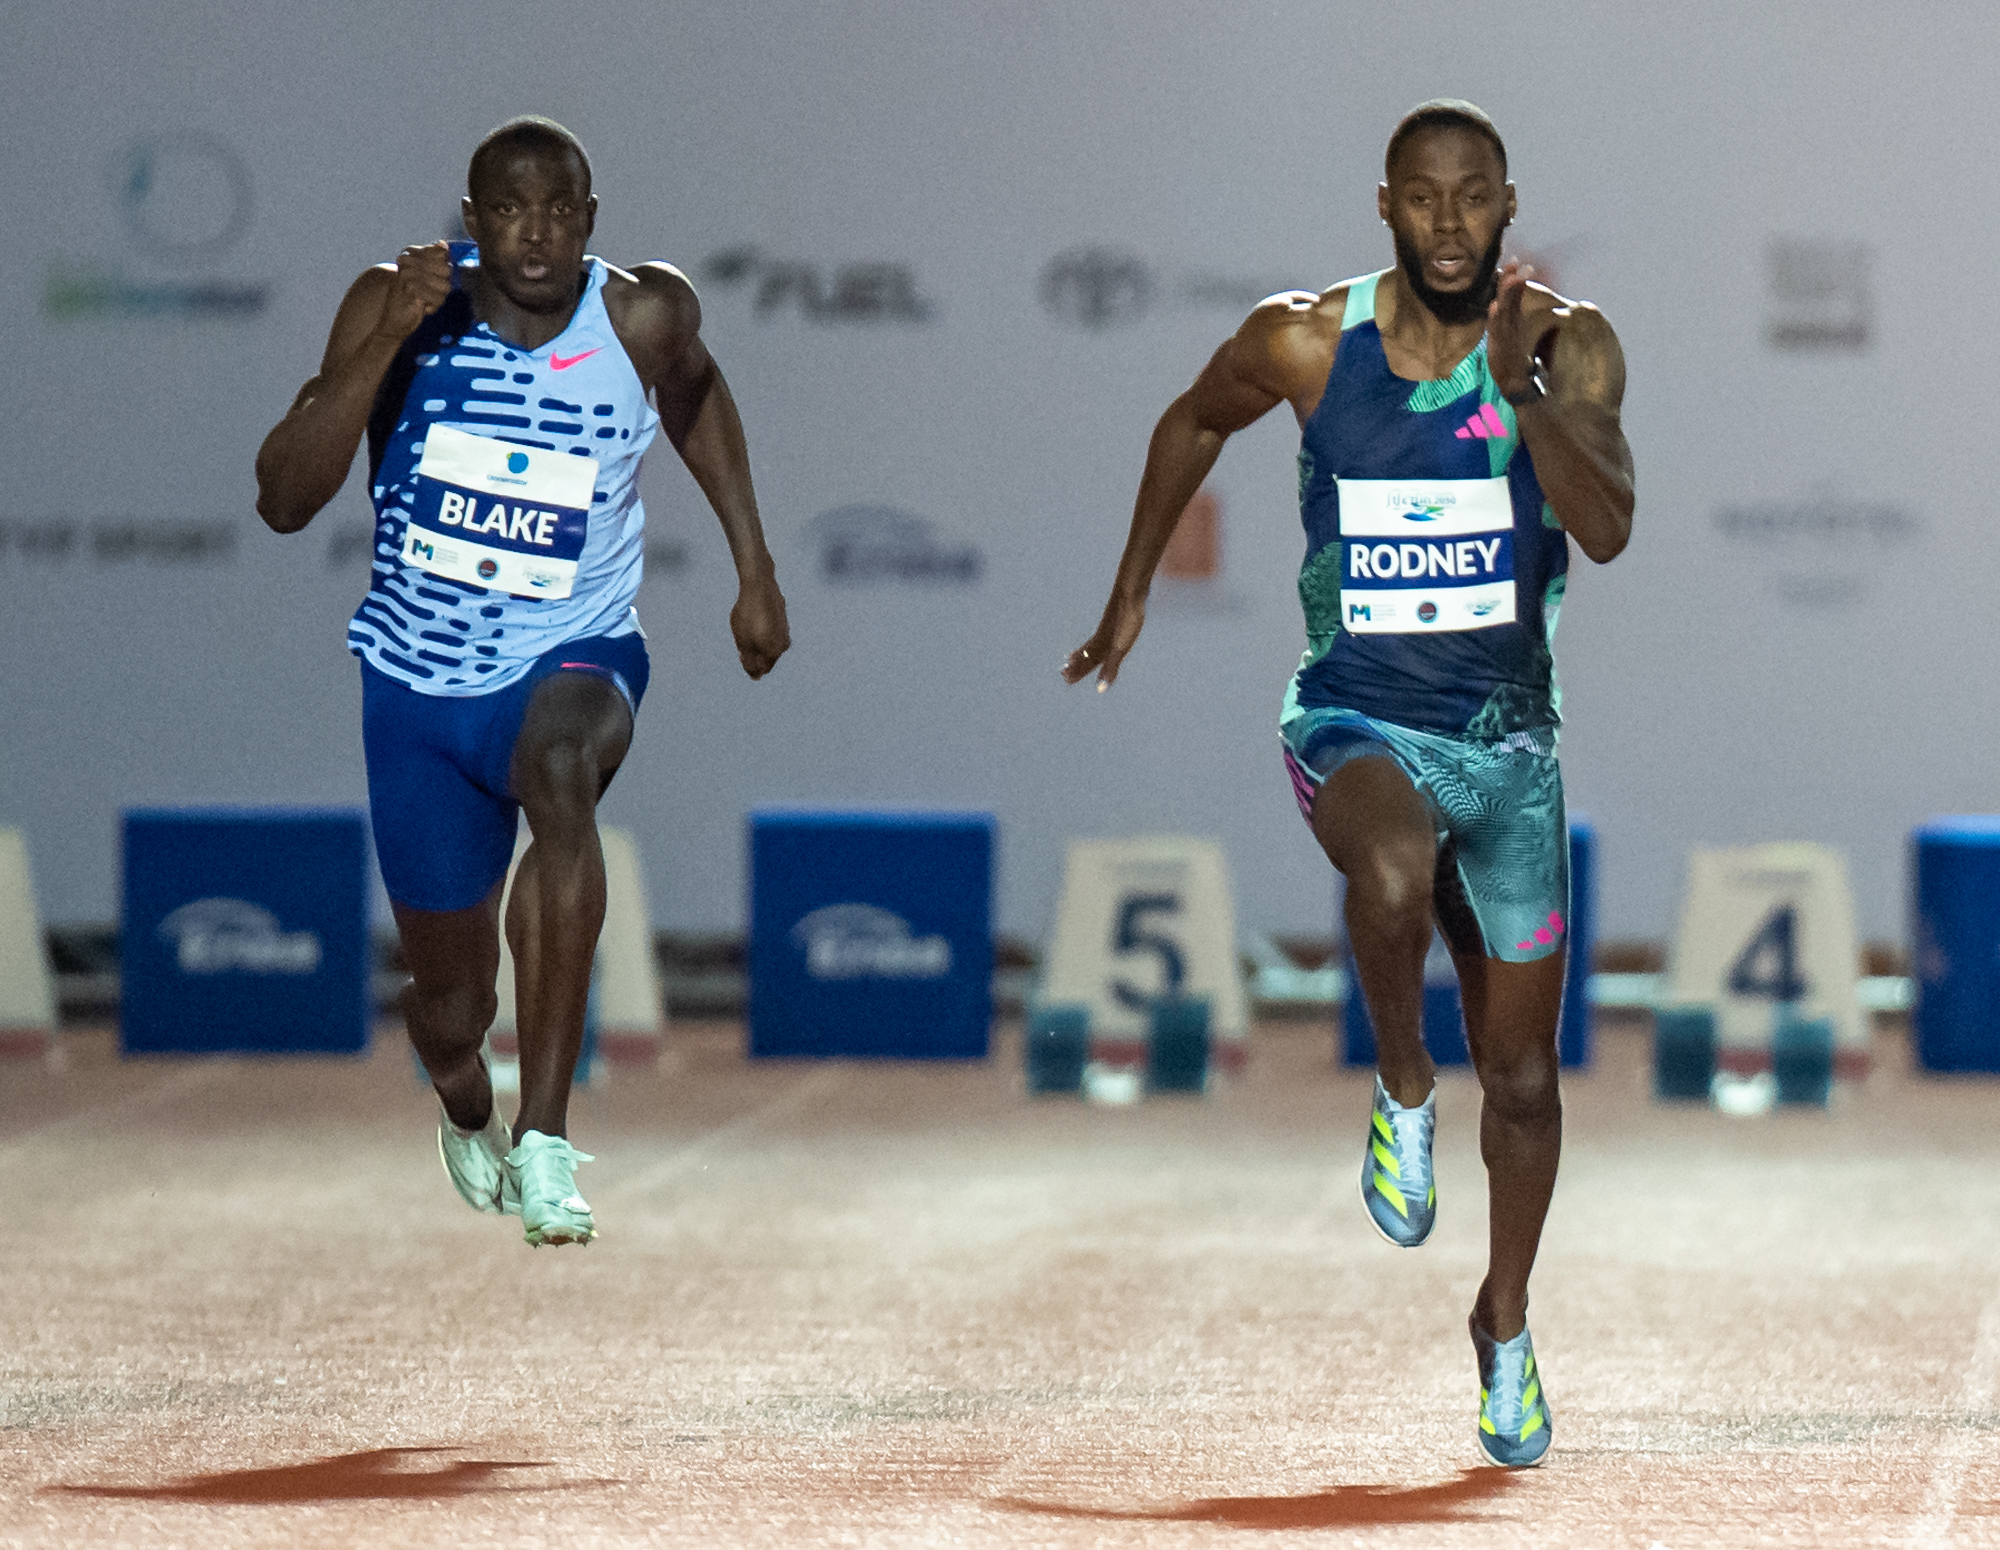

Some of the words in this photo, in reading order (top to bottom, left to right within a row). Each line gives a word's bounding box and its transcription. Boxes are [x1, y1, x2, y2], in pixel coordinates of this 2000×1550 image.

[438, 490, 559, 546] BLAKE
[1350, 538, 1501, 579] RODNEY
[1349, 604, 1371, 623] M
[1110, 890, 1187, 1012] 5
[1727, 901, 1808, 1002] 4
